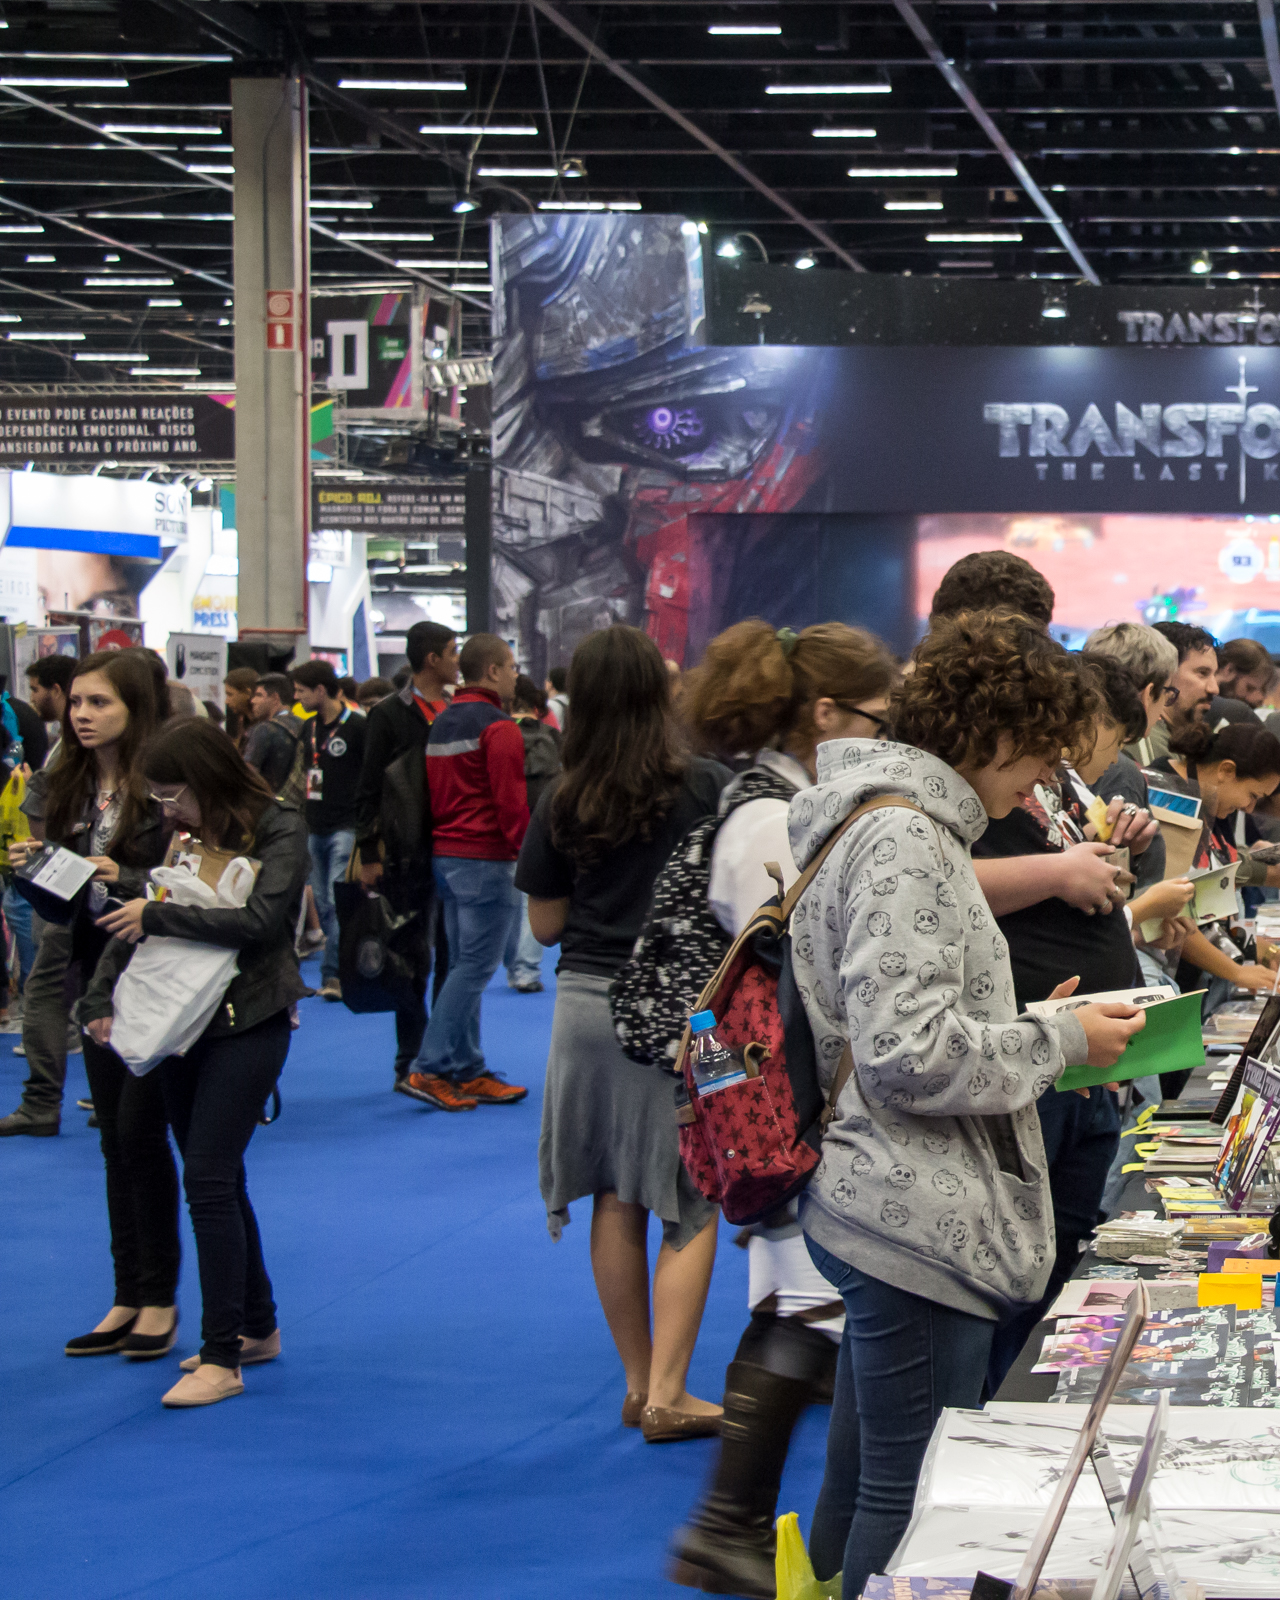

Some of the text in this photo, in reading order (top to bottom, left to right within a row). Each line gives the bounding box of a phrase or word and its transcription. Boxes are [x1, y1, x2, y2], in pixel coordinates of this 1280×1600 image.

[327, 321, 369, 390] D
[7, 406, 195, 422] EVENTO PODE CAUSAR REAÇÕES
[82, 425, 154, 437] EMOCIONAL.
[159, 425, 195, 437] RISCO
[69, 441, 100, 453] PARA
[104, 441, 112, 453] O
[116, 438, 169, 453] PRÓXIMO
[1035, 463, 1105, 482] THE
[1132, 463, 1229, 482] LAST
[194, 612, 229, 627] PRESS
